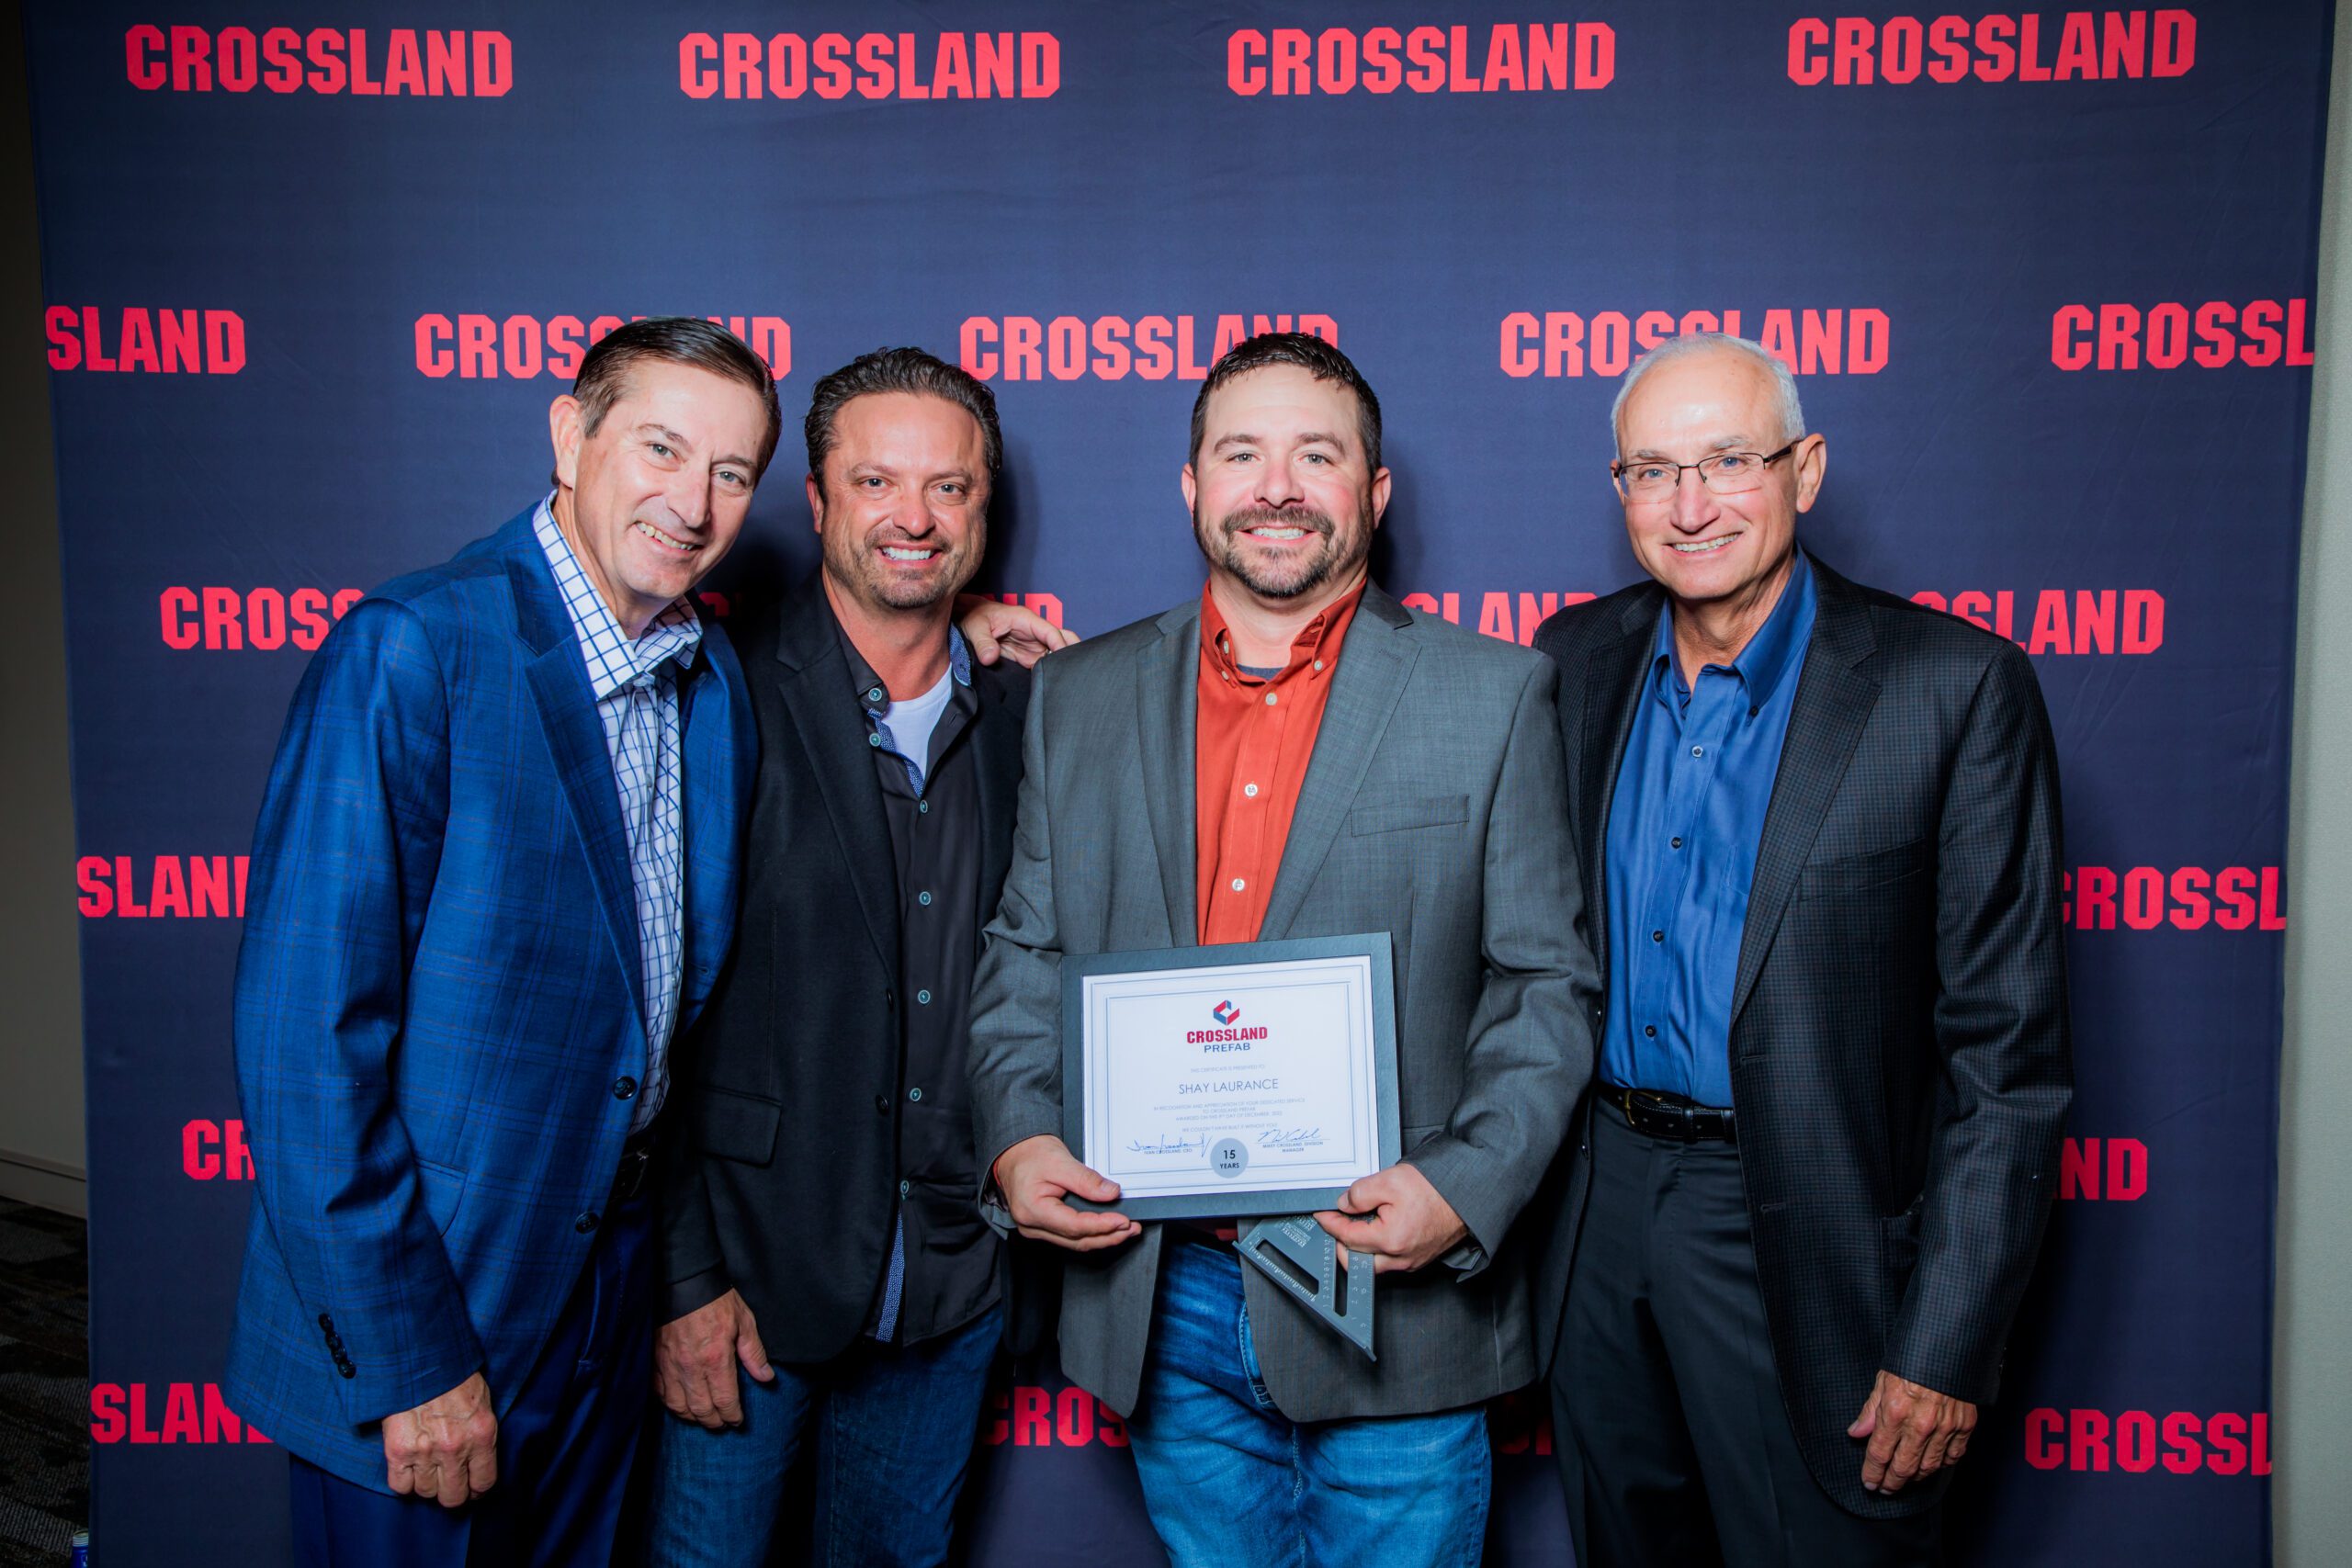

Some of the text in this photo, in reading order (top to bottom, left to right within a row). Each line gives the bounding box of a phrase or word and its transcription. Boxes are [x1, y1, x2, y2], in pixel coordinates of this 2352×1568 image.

[127, 26, 514, 97] CROSSLAND
[679, 32, 1060, 99] CROSSLAND
[1227, 22, 1615, 96] CROSSLAND
[1787, 10, 2197, 85] CROSSLAND
[45, 306, 246, 374] SLAND
[414, 314, 791, 380] CROSD
[2052, 299, 2314, 371] CROSSL
[2064, 866, 2287, 931] ROSSL
[1187, 1026, 1268, 1043] CROSSLAND
[1204, 1043, 1250, 1054] PREFAB
[1179, 1078, 1278, 1095] SHAY LAURANCE
[1223, 1150, 1236, 1160] 15
[91, 1383, 275, 1444] SLAN
